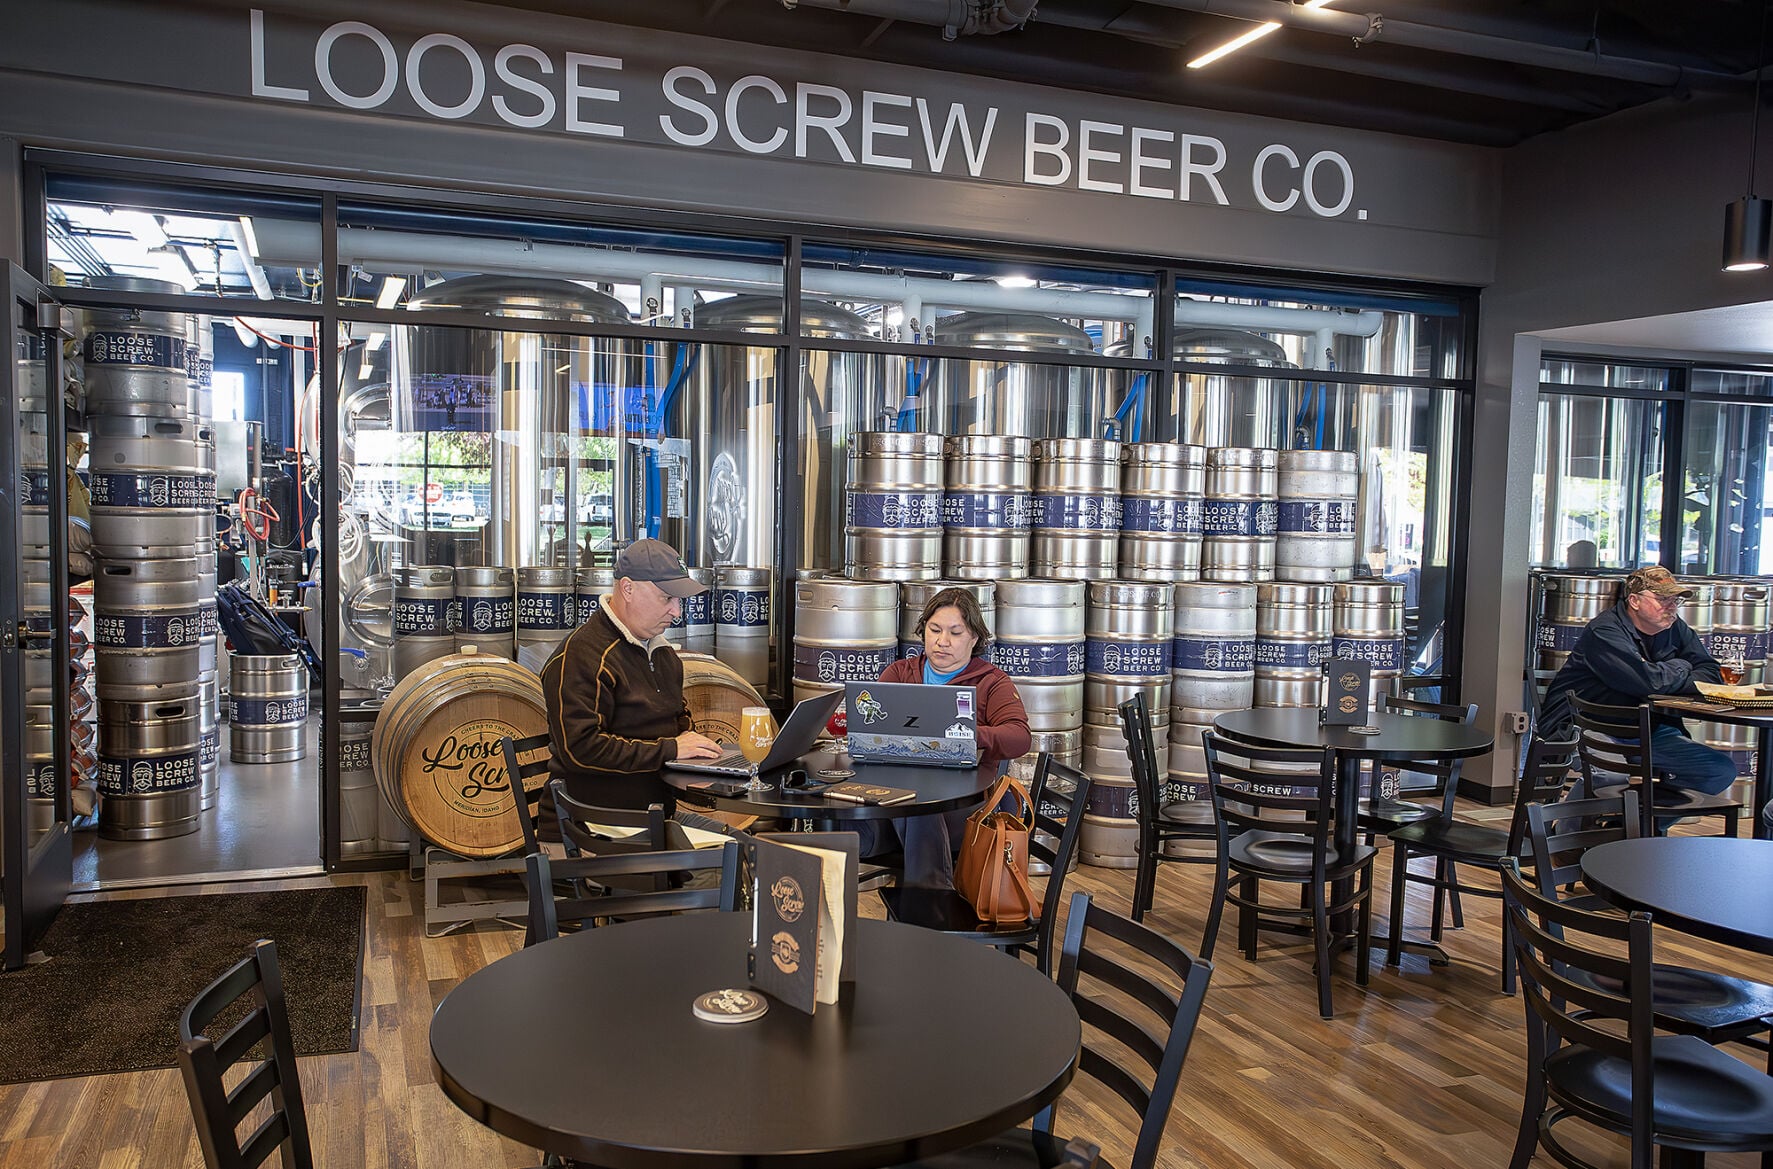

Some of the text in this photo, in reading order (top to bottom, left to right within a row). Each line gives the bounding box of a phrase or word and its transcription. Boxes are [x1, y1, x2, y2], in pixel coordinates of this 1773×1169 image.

[250, 8, 1369, 221] LOOSE SCREW BEER CO.
[110, 336, 154, 347] LOOSE
[110, 345, 154, 355] SCREW
[396, 603, 435, 614] LOOSE
[495, 602, 513, 611] LOO
[520, 599, 553, 608] OOSE
[396, 612, 435, 622] SCREW
[495, 612, 513, 620] SCR
[520, 608, 553, 617] CREW
[96, 619, 126, 628] OOSE
[396, 622, 416, 630] BEER
[1124, 648, 1161, 656] LOOSE
[1257, 644, 1286, 652] LOOSE
[840, 654, 880, 663] LOOSE
[1123, 656, 1162, 664] SCREW
[1356, 652, 1393, 660] SCREW
[840, 664, 880, 673] SCREW
[461, 724, 484, 734] CHEERS
[496, 725, 506, 733] THE
[201, 738, 214, 746] OSE
[201, 746, 214, 756] REW
[343, 742, 369, 753] OSE
[343, 752, 369, 760] REW
[422, 736, 503, 773] Loose
[101, 764, 122, 773] OSE
[156, 758, 195, 771] LOOSE
[101, 773, 122, 782] REW
[156, 766, 195, 780] SCREW
[156, 777, 183, 787] BEER
[461, 762, 509, 798] Scr
[1167, 782, 1196, 794] OOSE
[1253, 784, 1292, 796] SCREW
[1167, 790, 1196, 801] CREW
[454, 800, 500, 813] MERIDIAN, IDAHO
